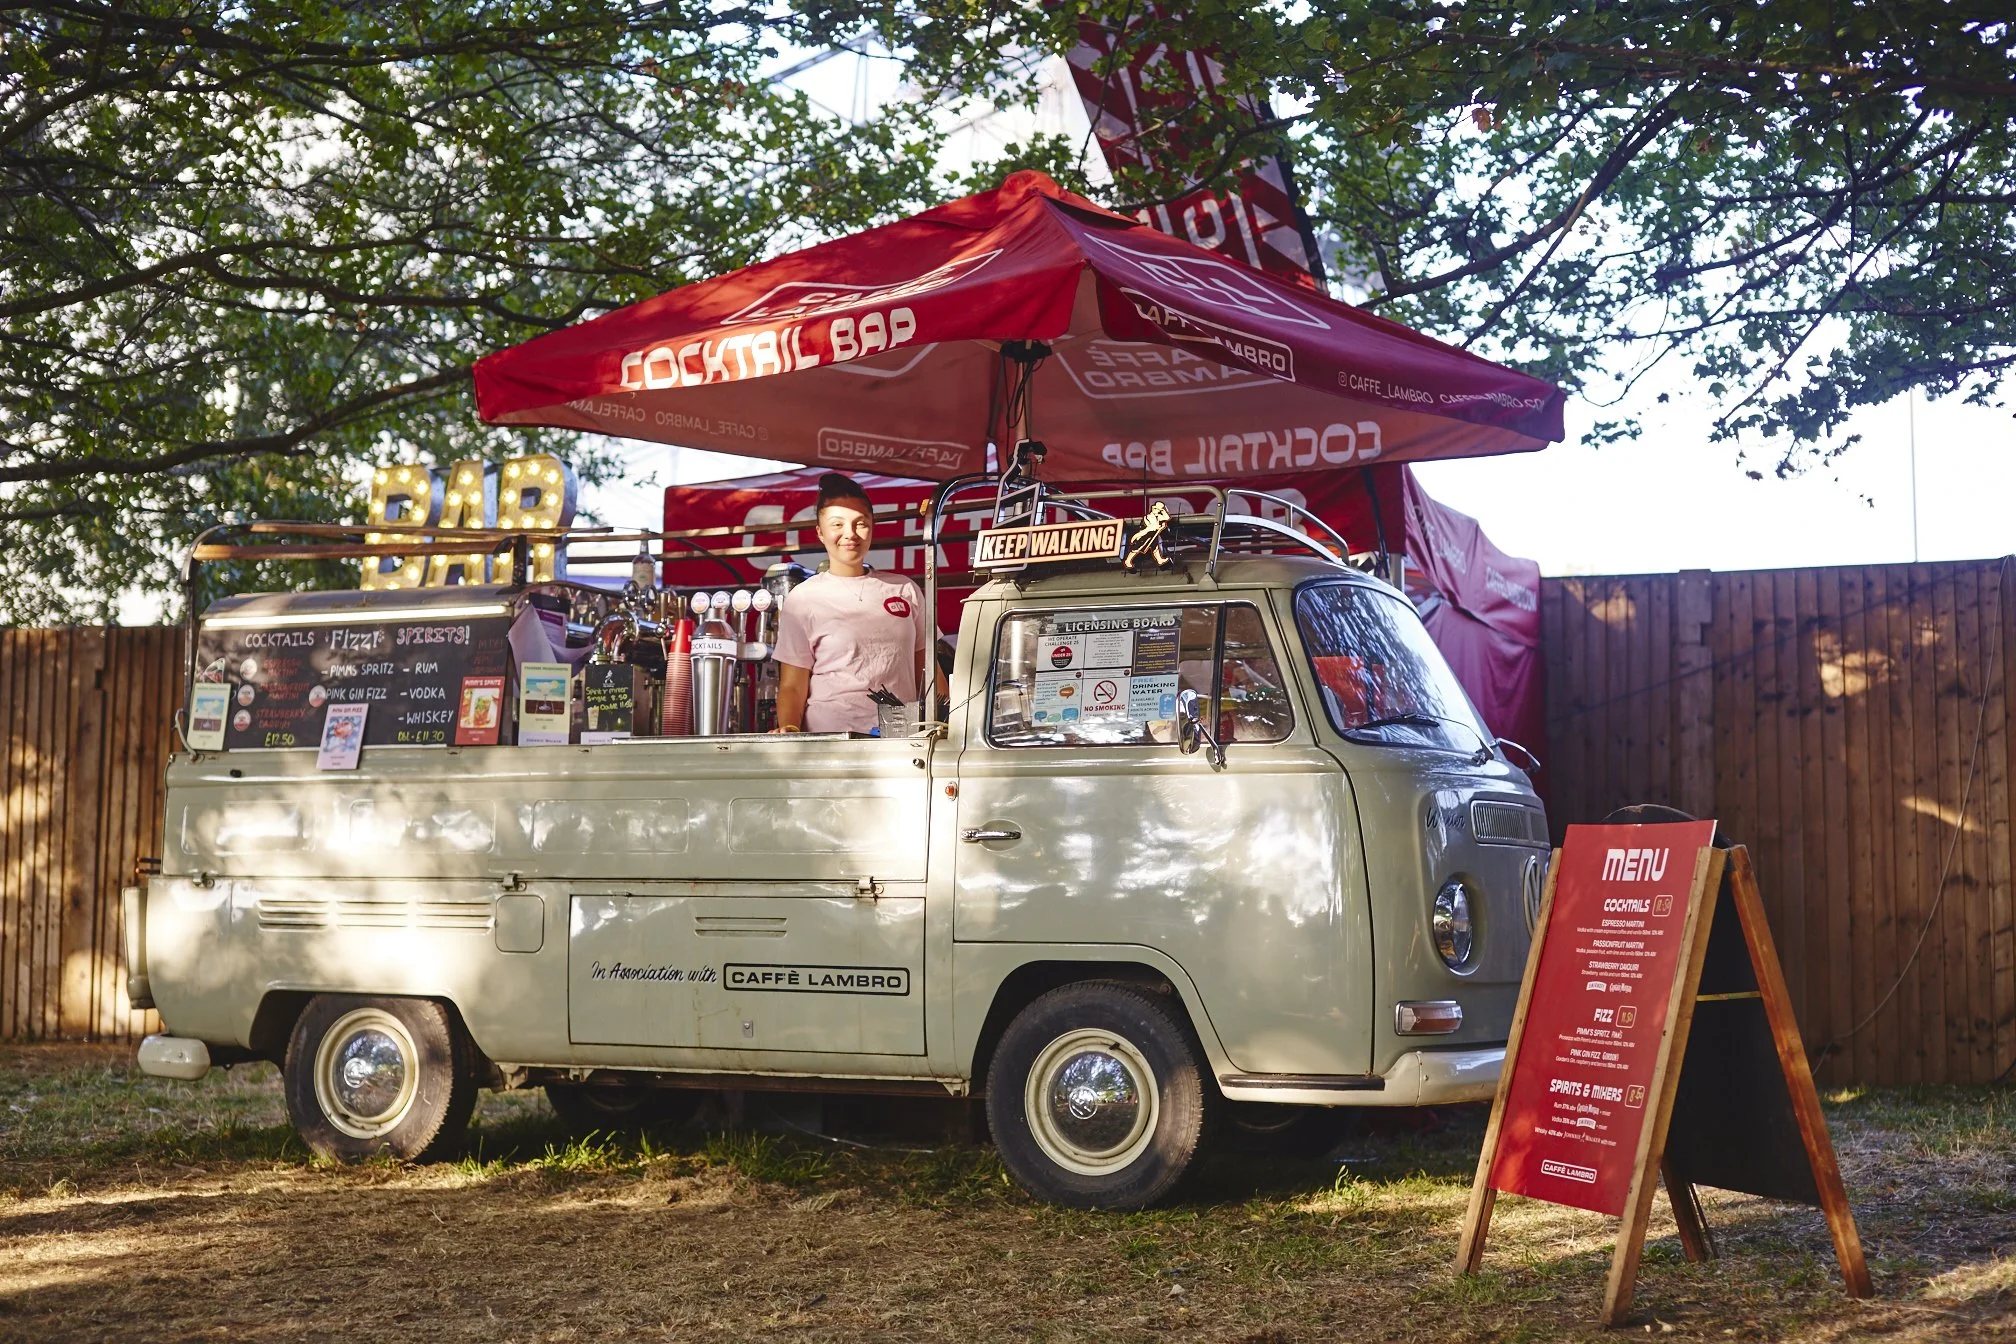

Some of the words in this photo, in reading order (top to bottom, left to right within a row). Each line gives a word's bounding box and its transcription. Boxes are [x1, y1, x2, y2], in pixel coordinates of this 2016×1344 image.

[619, 326, 821, 390] COCKTAIL
[829, 307, 917, 363] BAR
[361, 453, 578, 592] BAR
[980, 532, 1028, 562] KEEP
[1030, 524, 1117, 557] WALKING
[1065, 618, 1129, 632] LICENSING
[1133, 617, 1176, 629] BOARD
[245, 632, 315, 648] COCKTAILS
[396, 625, 470, 645] SPIRITS!
[361, 663, 394, 675] SPRITZ
[415, 662, 438, 674] RUM
[325, 688, 346, 700] PINK
[349, 688, 364, 700] GIN
[367, 688, 387, 700] FIZZ
[410, 688, 446, 700] VODKA
[406, 710, 455, 724] WHISKEY
[265, 732, 295, 746] £12.50
[1602, 848, 1670, 882] MENU
[1603, 898, 1651, 912] COCKTAILS
[1602, 919, 1626, 927] ESPRESSO
[1592, 940, 1626, 948] PASSIONFRUIT
[1589, 961, 1620, 970] STRAWBERRY
[592, 960, 606, 980] In
[610, 962, 685, 983] Association
[688, 964, 717, 983] with
[732, 970, 800, 986] CAFFÈ
[808, 974, 902, 989] LAMBRO
[1593, 1008, 1614, 1022] FIZZ
[1576, 1027, 1594, 1036] PIMM'S
[1594, 1029, 1611, 1038] SPRITZ
[1570, 1049, 1582, 1057] PINK
[1591, 1051, 1601, 1059] FIZZ
[1550, 1078, 1582, 1096] SPIRITS
[1582, 1084, 1590, 1097] &
[1591, 1085, 1623, 1102] MIXERS
[1544, 1164, 1566, 1175] CAFFÈ
[1567, 1168, 1594, 1180] LAMBRO
